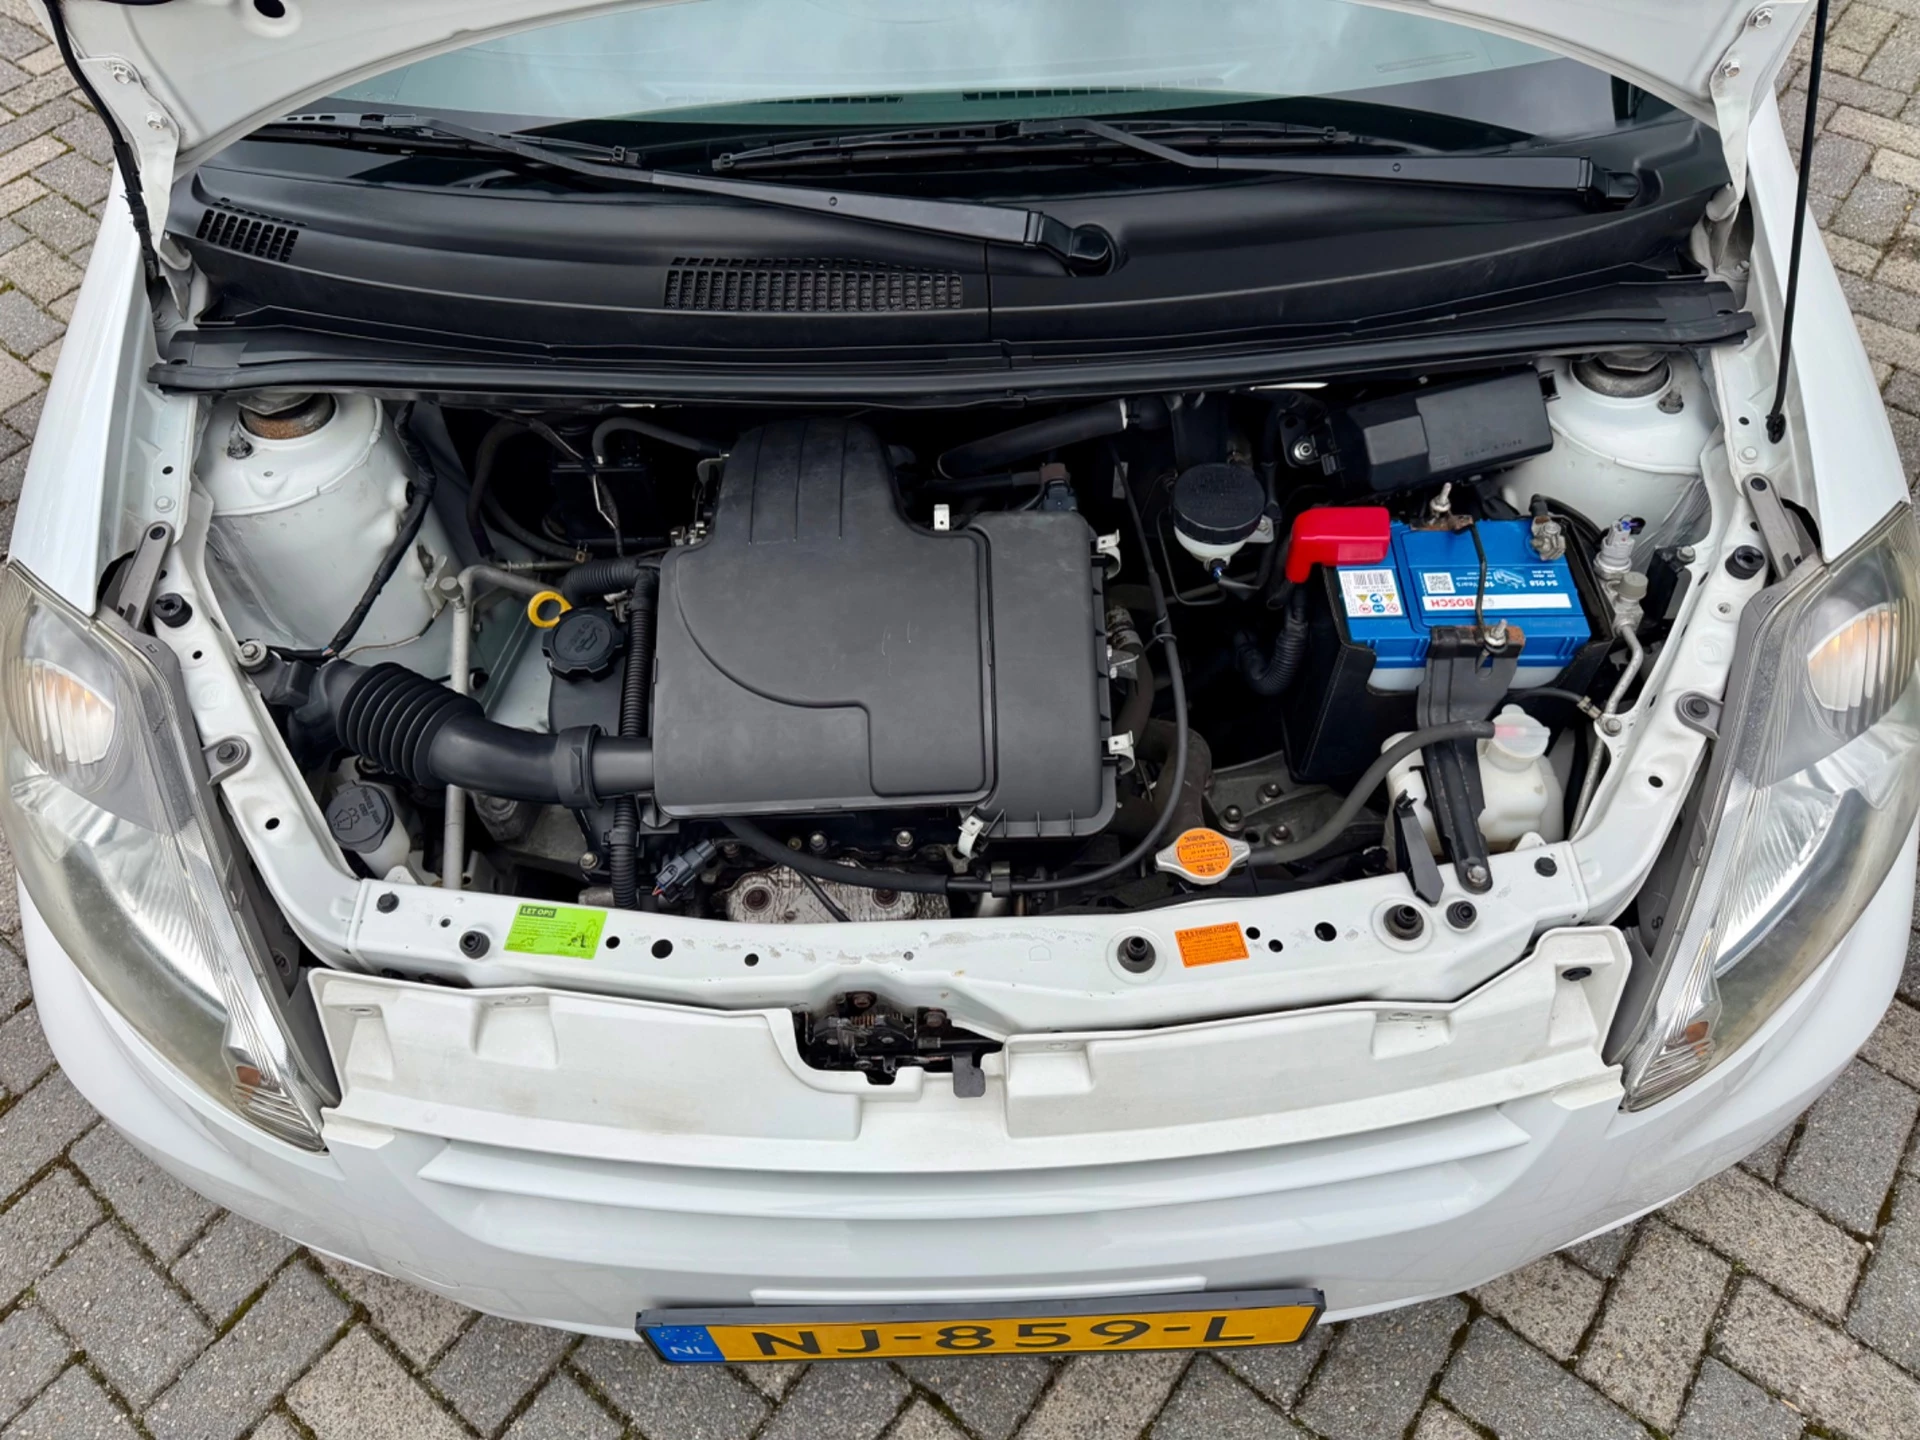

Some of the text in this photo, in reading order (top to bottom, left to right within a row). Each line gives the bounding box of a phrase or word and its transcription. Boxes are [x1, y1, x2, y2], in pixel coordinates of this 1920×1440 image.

[1430, 598, 1475, 608] BOSCH
[522, 907, 537, 915] LET
[670, 1316, 1255, 1356] NL NJ-859-L
